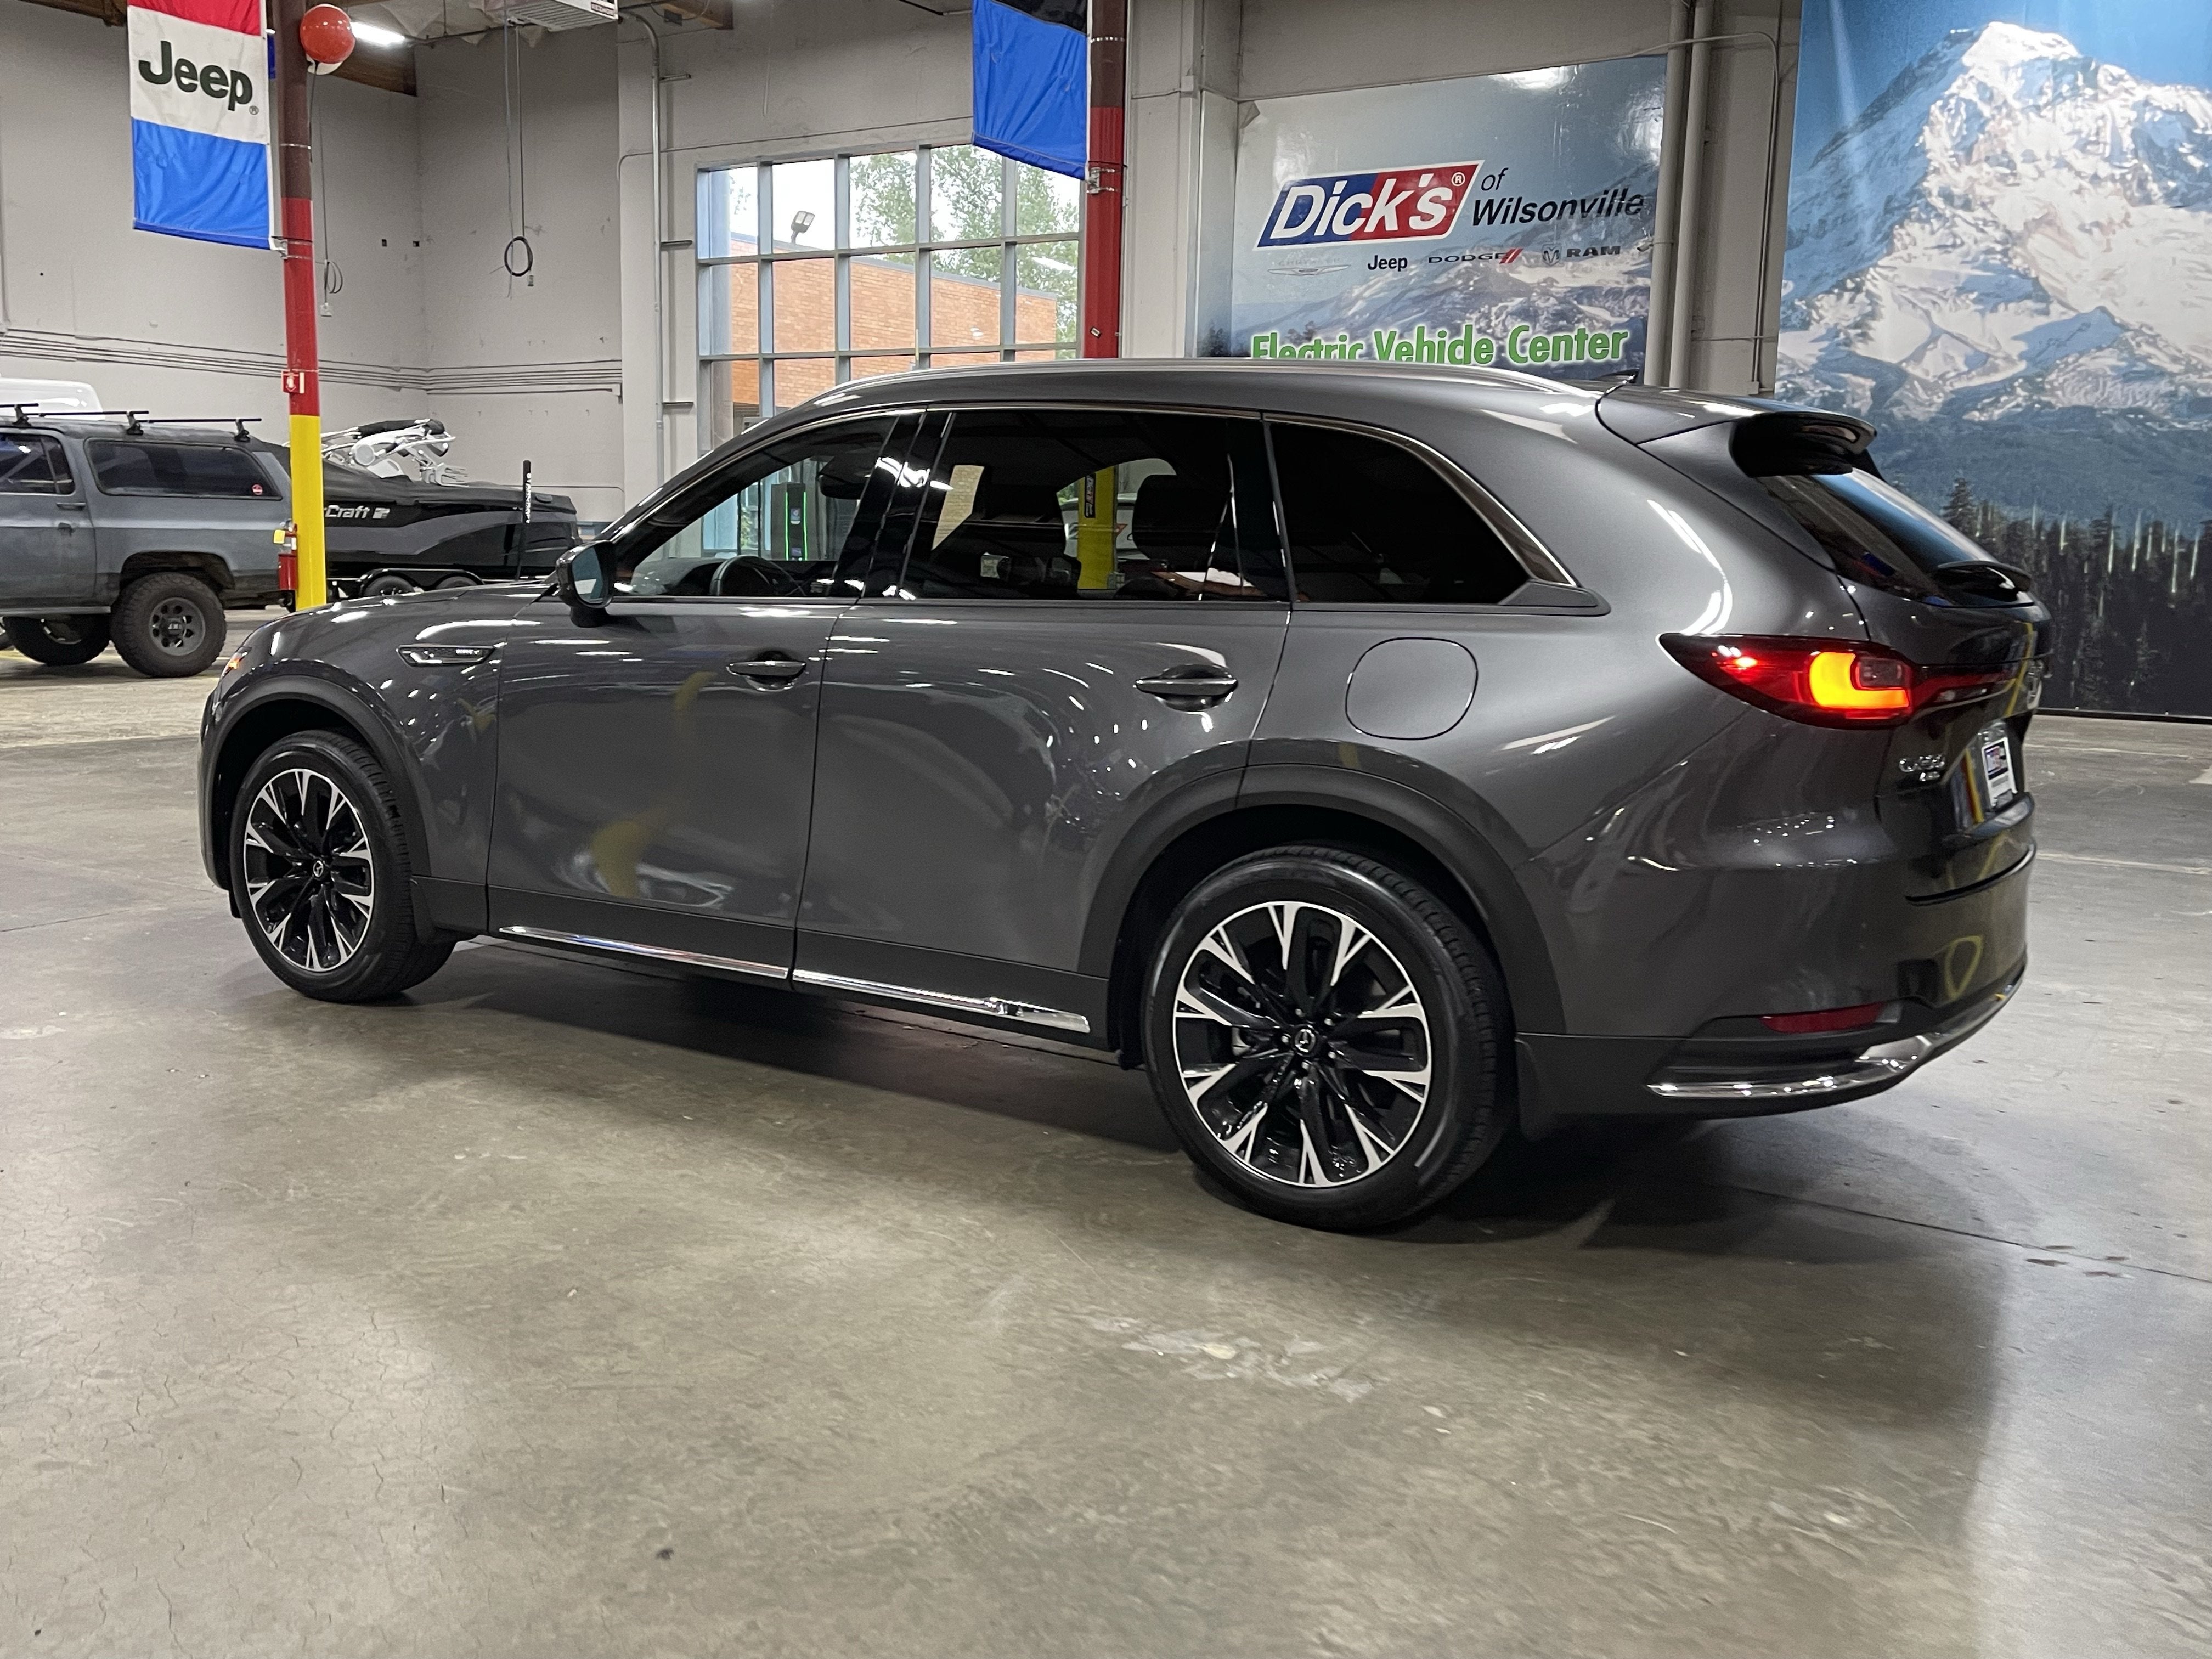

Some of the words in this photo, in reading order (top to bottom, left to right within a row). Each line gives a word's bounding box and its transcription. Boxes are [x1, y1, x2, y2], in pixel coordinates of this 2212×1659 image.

[138, 41, 253, 111] Jeep
[1481, 167, 1509, 191] of
[1472, 187, 1644, 227] Wilsonville
[1428, 252, 1508, 263] DODGE
[1566, 245, 1621, 257] RAM
[1367, 255, 1408, 272] Jeep
[1252, 332, 1364, 360] Electric
[1374, 324, 1494, 365] Vehicle
[1508, 324, 1629, 364] Center
[324, 504, 370, 519] Craft
